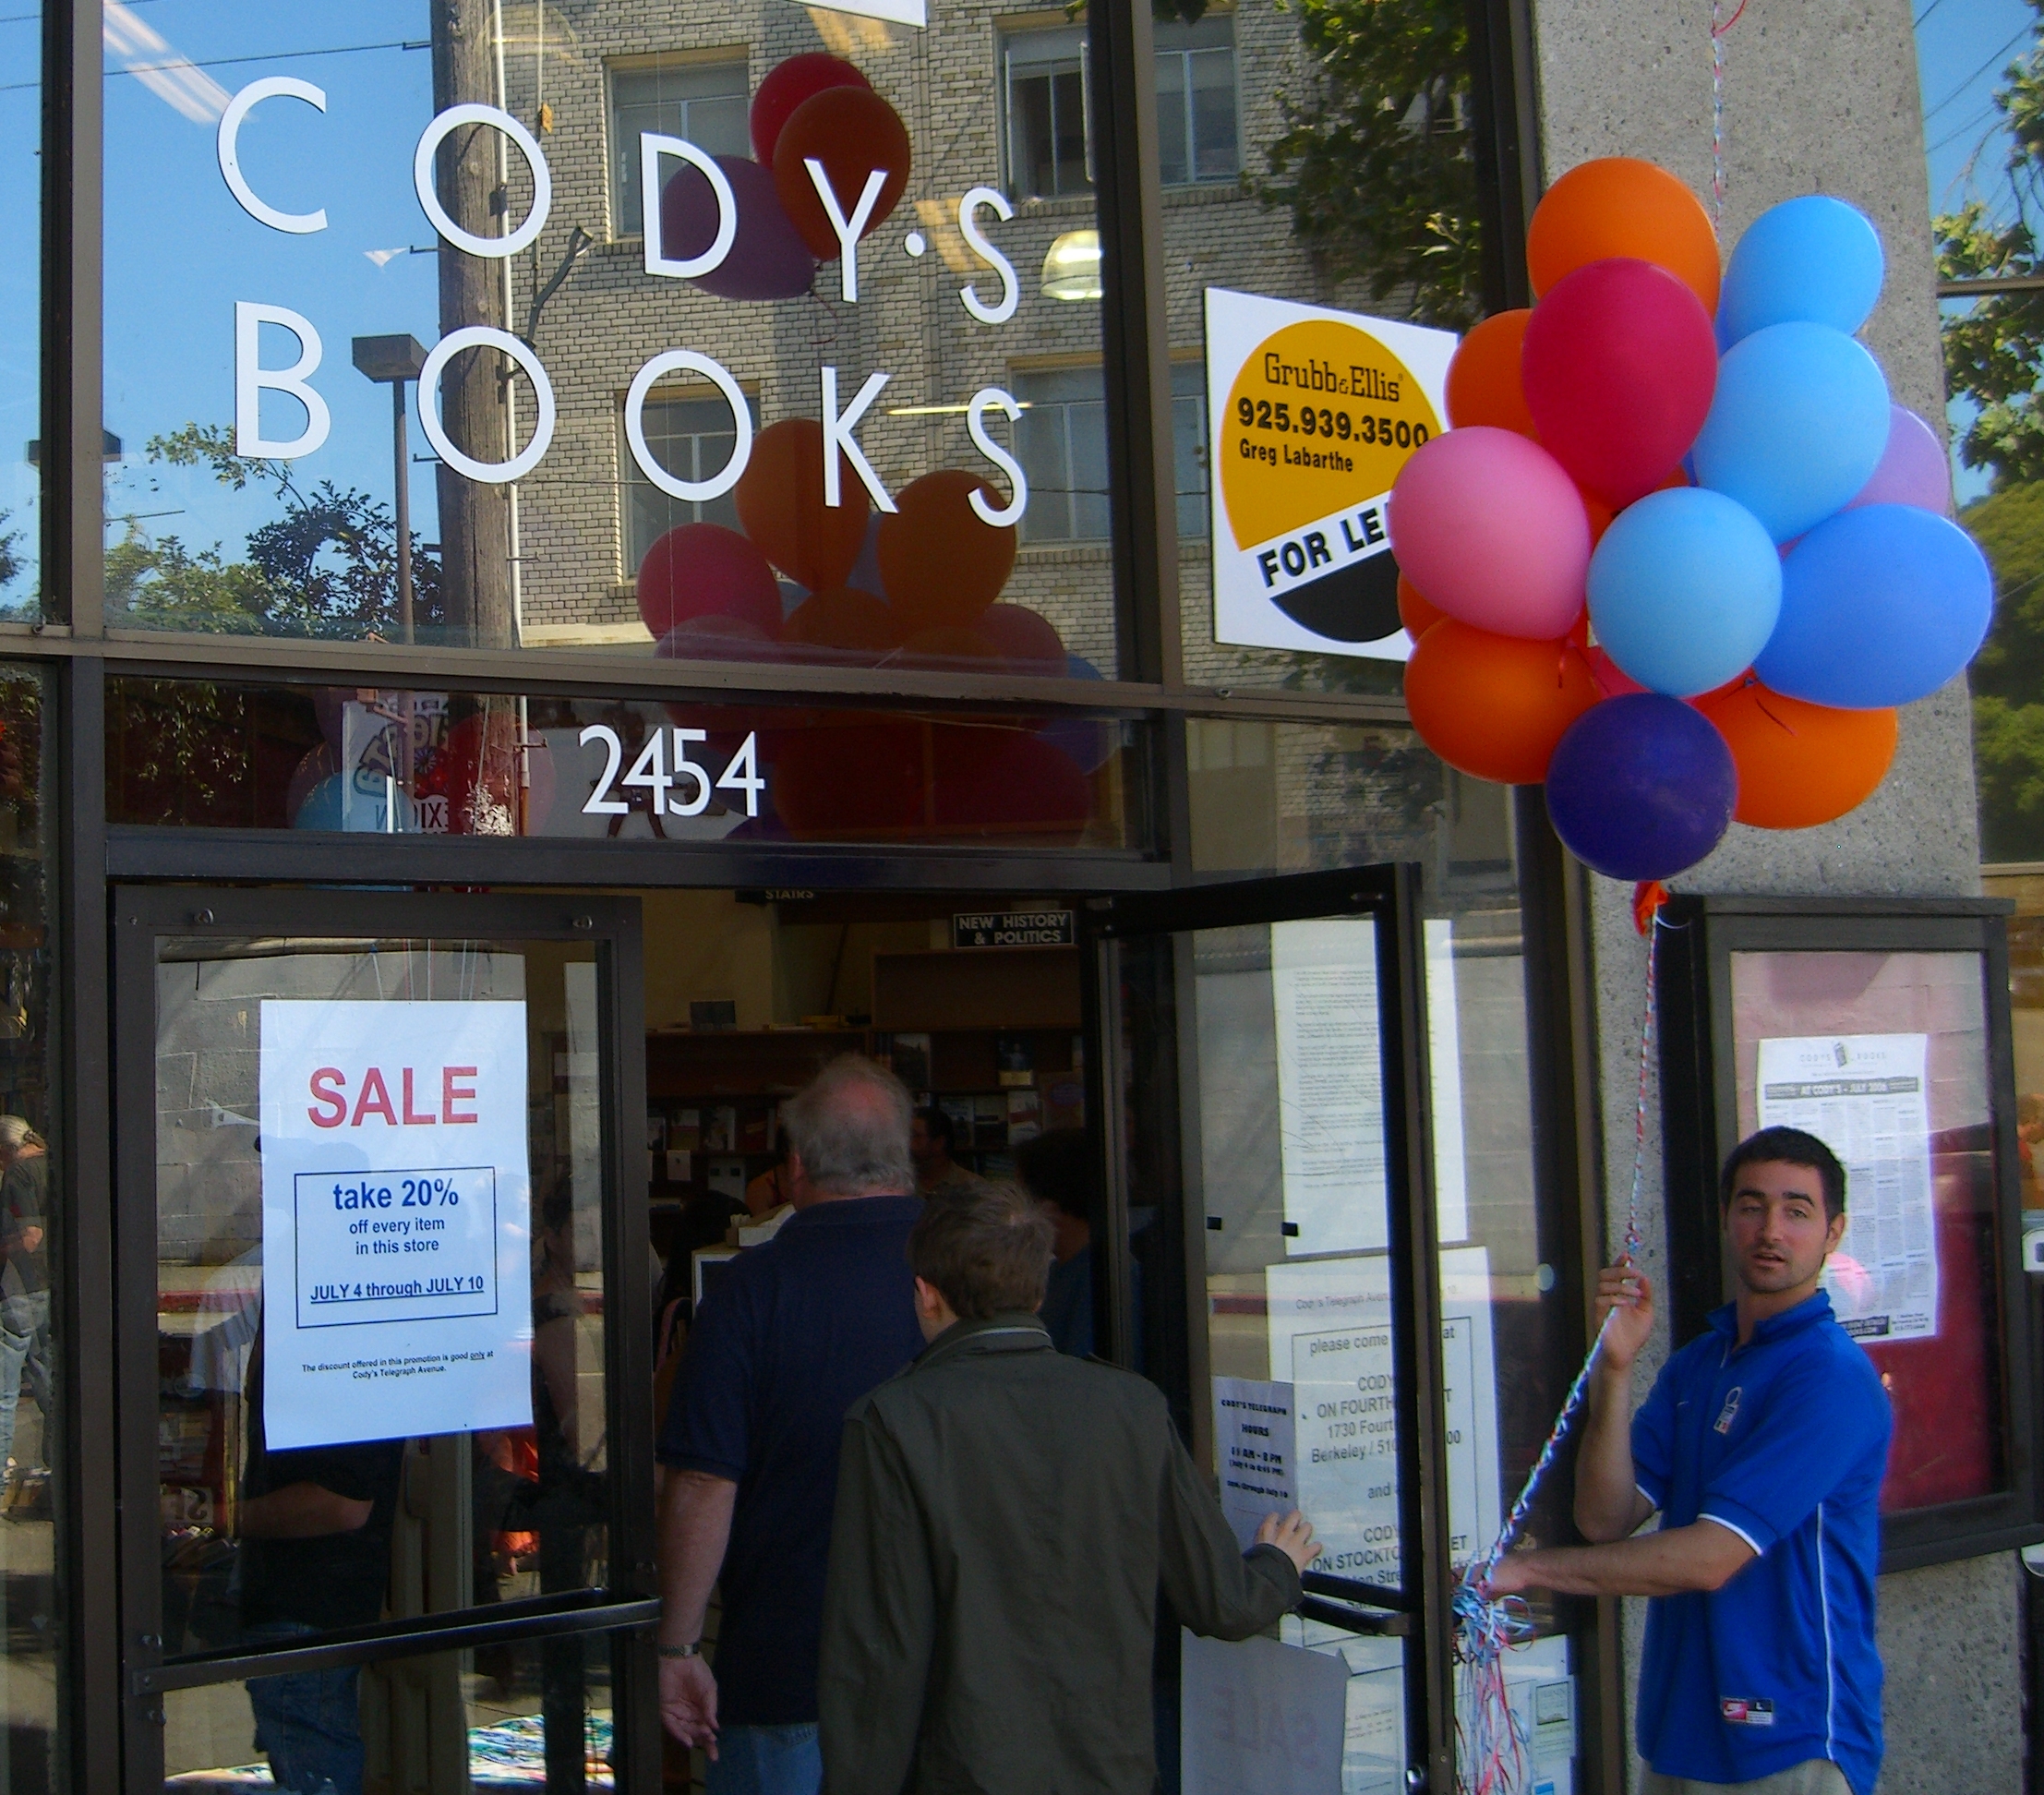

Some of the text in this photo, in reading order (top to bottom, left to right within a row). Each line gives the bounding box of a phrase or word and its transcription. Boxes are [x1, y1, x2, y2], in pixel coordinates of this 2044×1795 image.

[234, 300, 1028, 527] BOOKS
[1238, 397, 1429, 449] 925.939.3500
[1240, 439, 1353, 472] Greg Labarthe
[1256, 501, 1391, 588] FOR LE
[578, 724, 765, 817] 2454
[958, 913, 1067, 930] NEW HISTORY
[974, 930, 1062, 945] & POLITICS
[307, 1066, 478, 1128] SALE
[333, 1177, 459, 1211] take 20%
[349, 1217, 445, 1235] off every item
[355, 1238, 439, 1255] in this store
[310, 1275, 484, 1301] JULY 4 through JULY 10
[1310, 1334, 1389, 1356] please come
[302, 1350, 494, 1372] The discount offered in this promotion is good only at
[353, 1365, 447, 1379] Cody's Telegraph Avenue.
[1317, 1403, 1338, 1419] ON
[1242, 1424, 1268, 1436] HOURS
[1328, 1422, 1356, 1438] 1730
[1269, 1453, 1282, 1464] PM
[1311, 1444, 1365, 1464] Berkeley
[1368, 1483, 1391, 1499] and
[1313, 1555, 1332, 1572] ON
